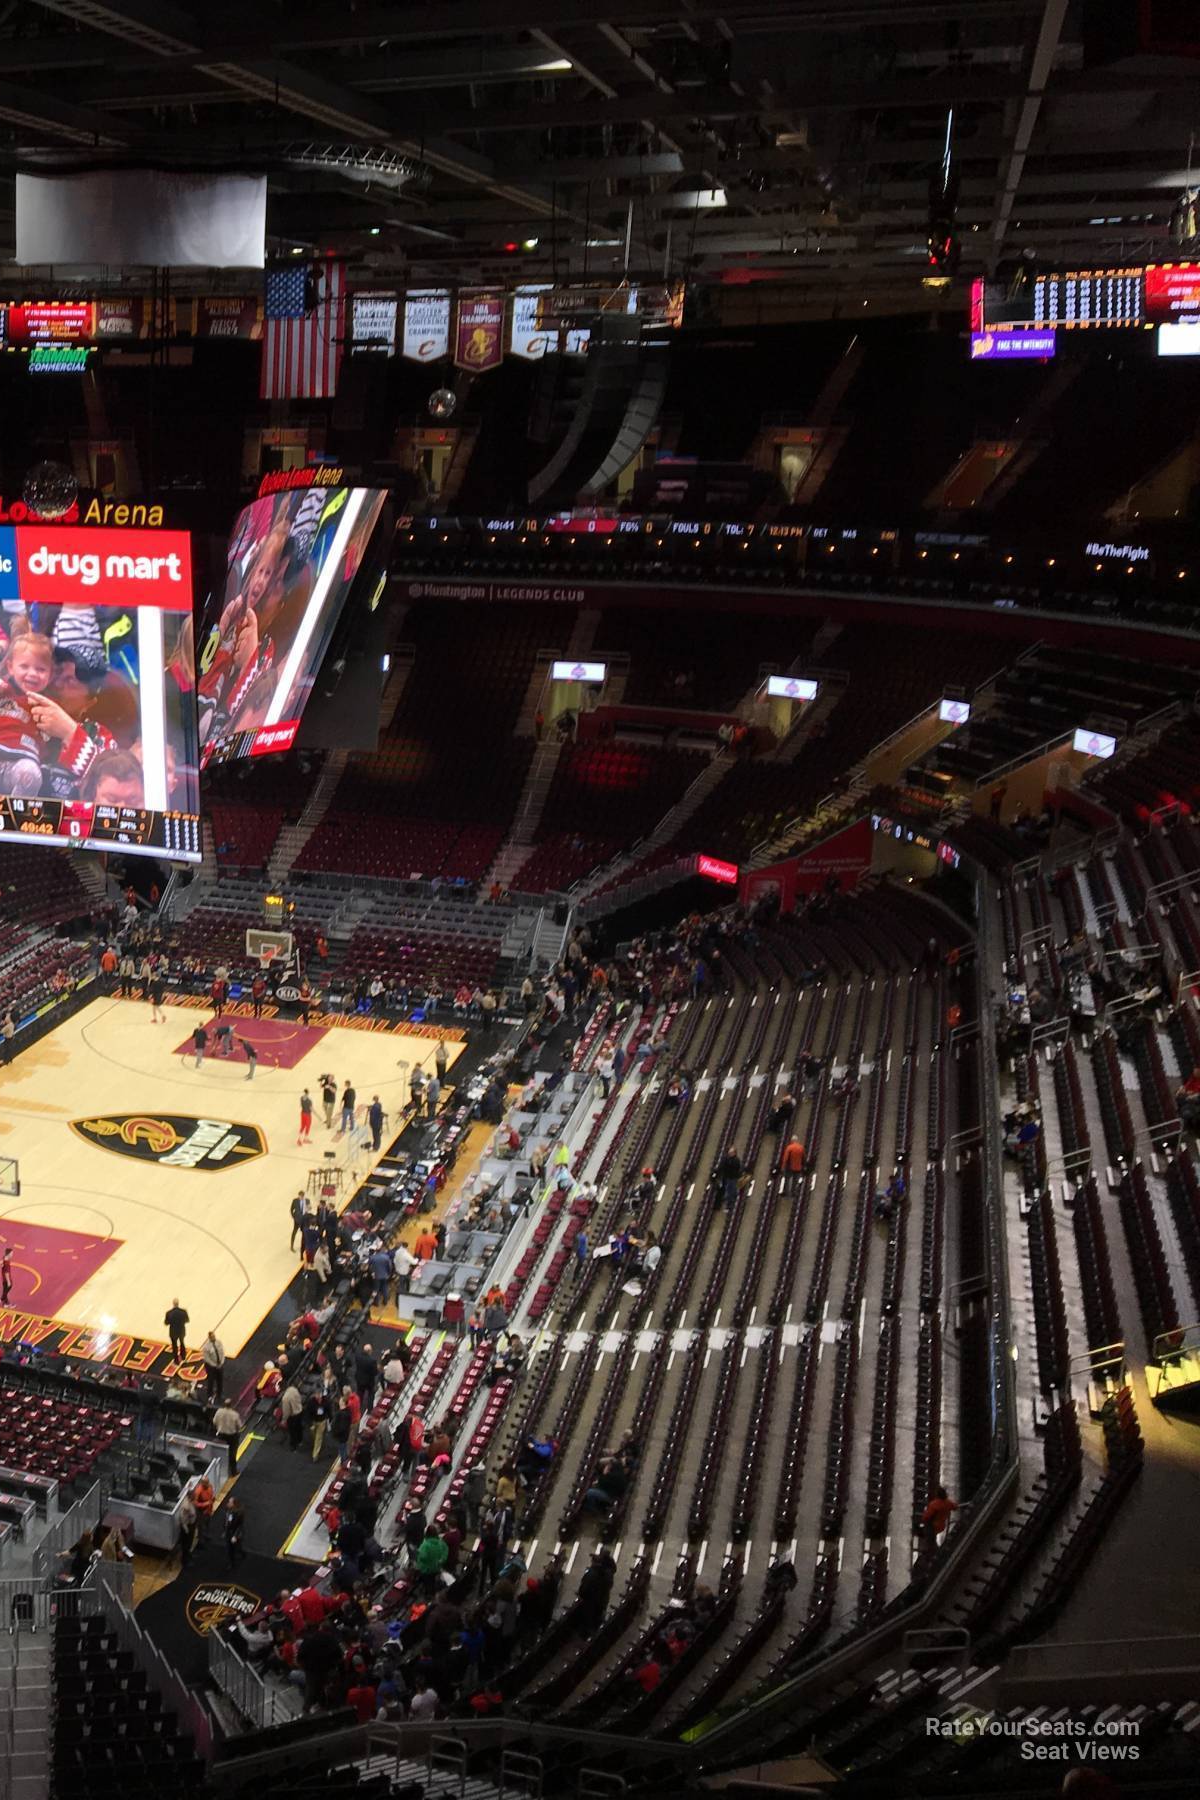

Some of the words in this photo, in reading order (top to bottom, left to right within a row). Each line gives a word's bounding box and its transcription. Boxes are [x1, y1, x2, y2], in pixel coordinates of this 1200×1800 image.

[413, 308, 442, 316] EASTERN
[473, 304, 489, 315] NBA
[408, 318, 448, 326] CONFERENCE
[461, 314, 501, 324] CHAMPIONS
[356, 330, 392, 338] CHAMPIONS
[408, 327, 446, 336] CHAMPIONS
[28, 362, 86, 374] COMMERCIAL
[312, 464, 344, 486] Arena
[84, 498, 164, 527] Arena
[672, 522, 699, 533] FOULS
[1086, 542, 1150, 561] #BeTheFight
[28, 546, 100, 585] drug
[105, 550, 182, 581] mart
[424, 584, 486, 599] Huntington
[496, 589, 550, 600] LEGENDS
[553, 589, 585, 601] CLUB
[20, 821, 54, 835] 49:42
[69, 820, 81, 837] 0
[280, 987, 298, 1000] KIA
[194, 1590, 256, 1615] CAVALIERS
